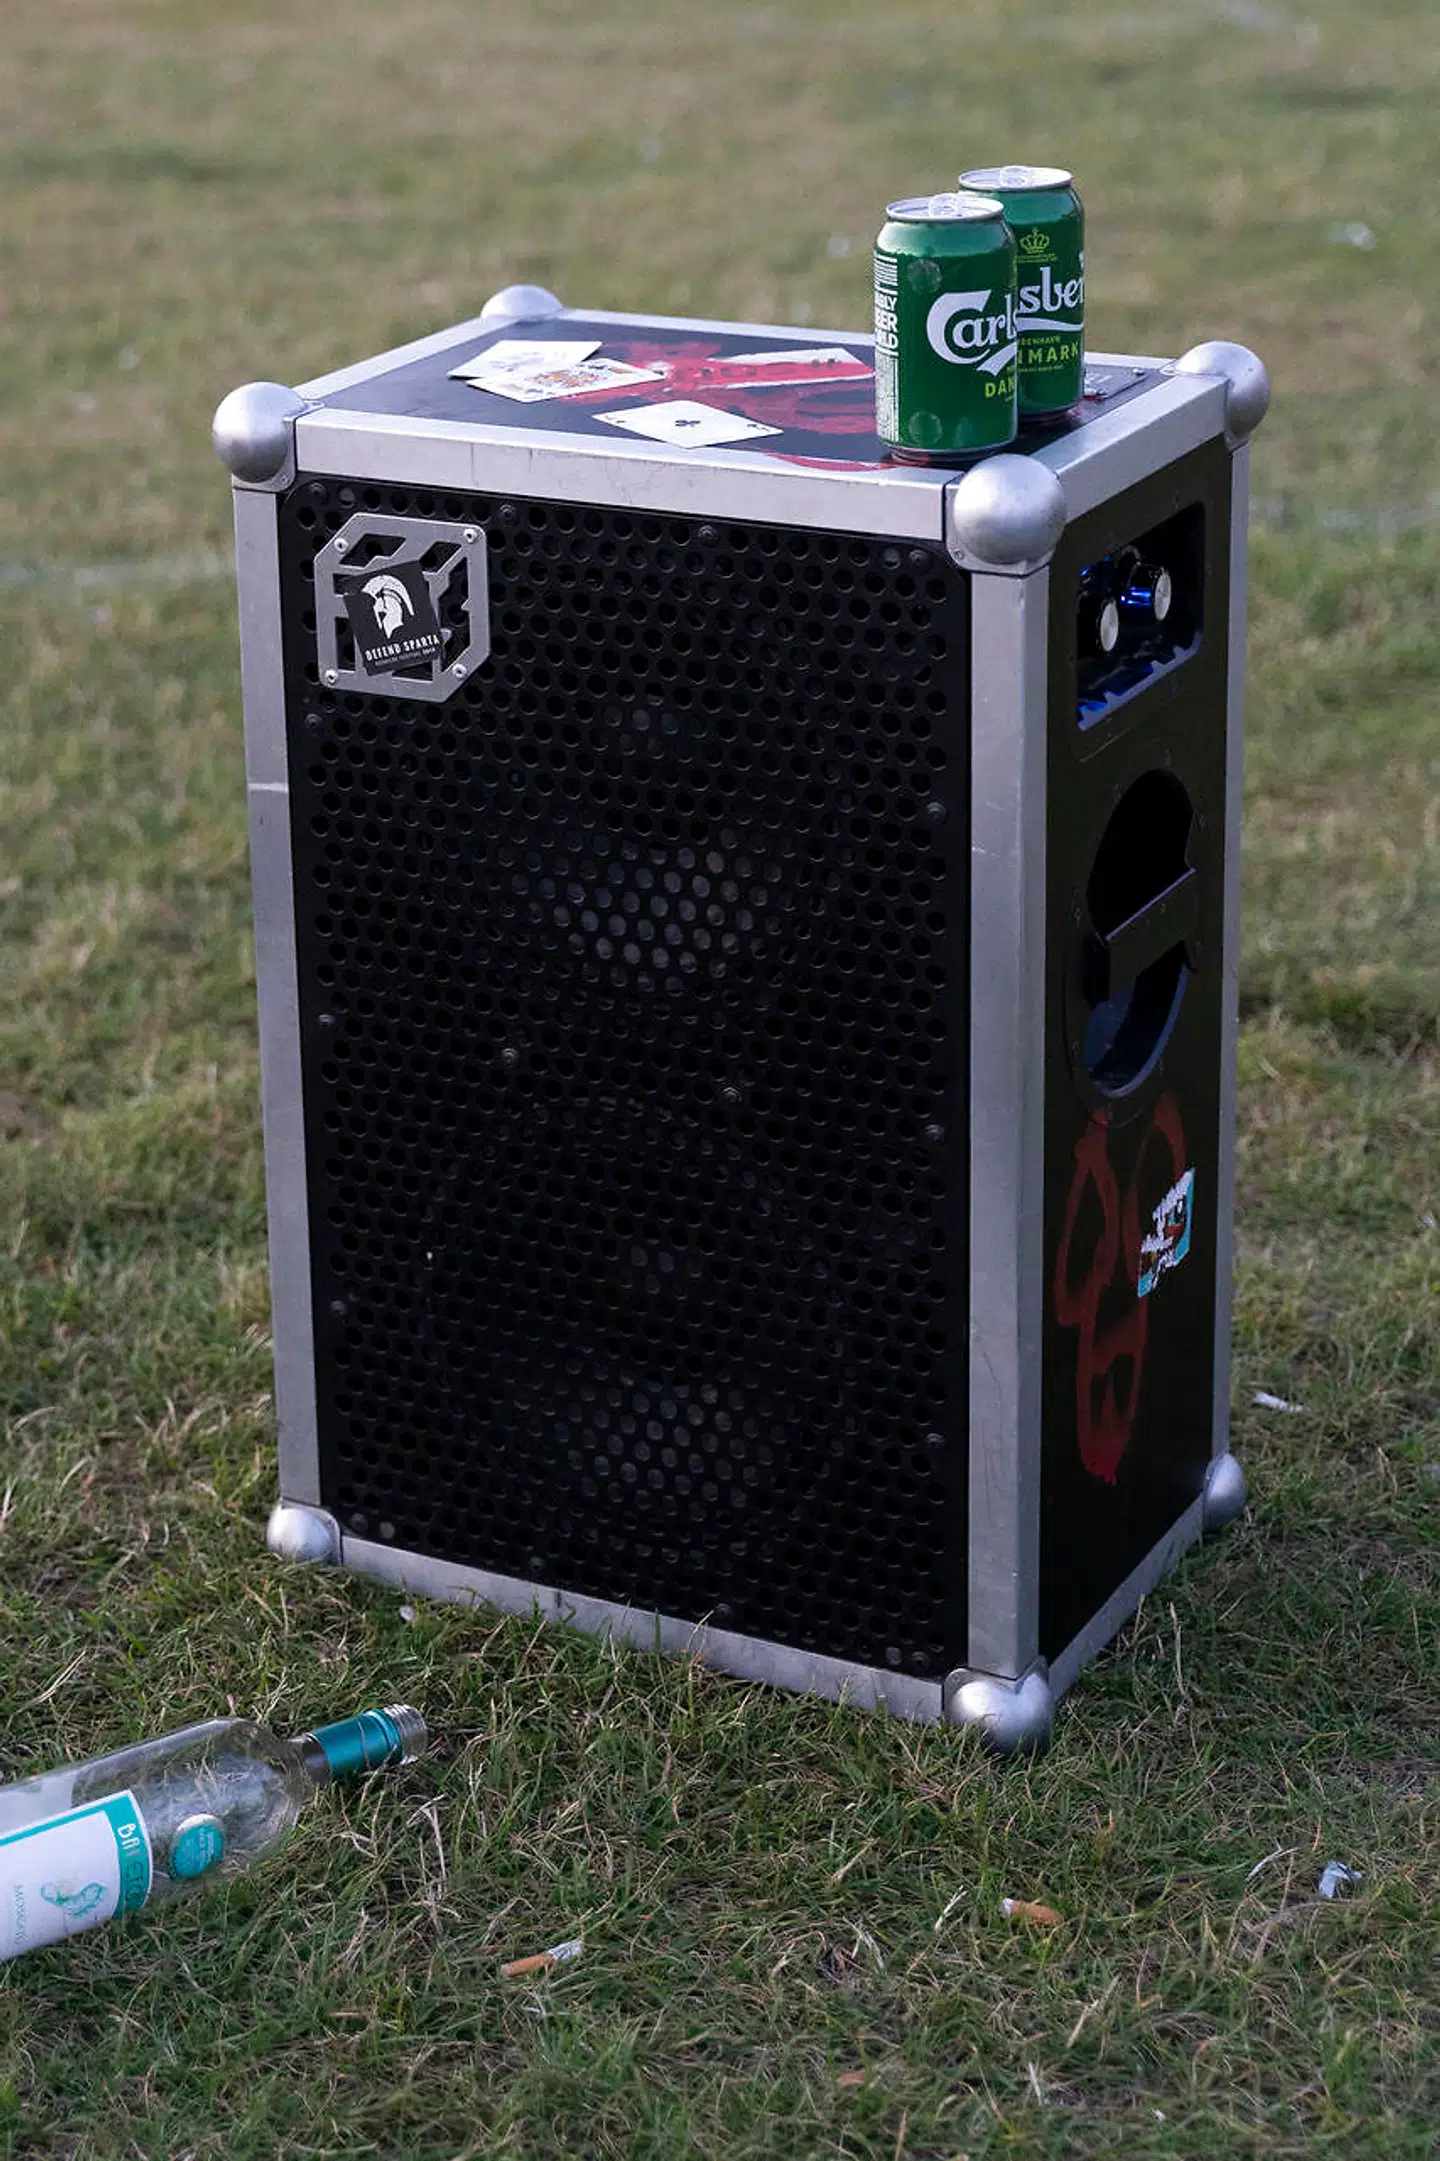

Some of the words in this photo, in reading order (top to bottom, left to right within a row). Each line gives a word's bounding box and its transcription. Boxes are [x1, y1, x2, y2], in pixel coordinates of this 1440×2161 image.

[926, 289, 1016, 365] Carl
[365, 643, 401, 661] DEFEND
[404, 634, 440, 652] SPARTA
